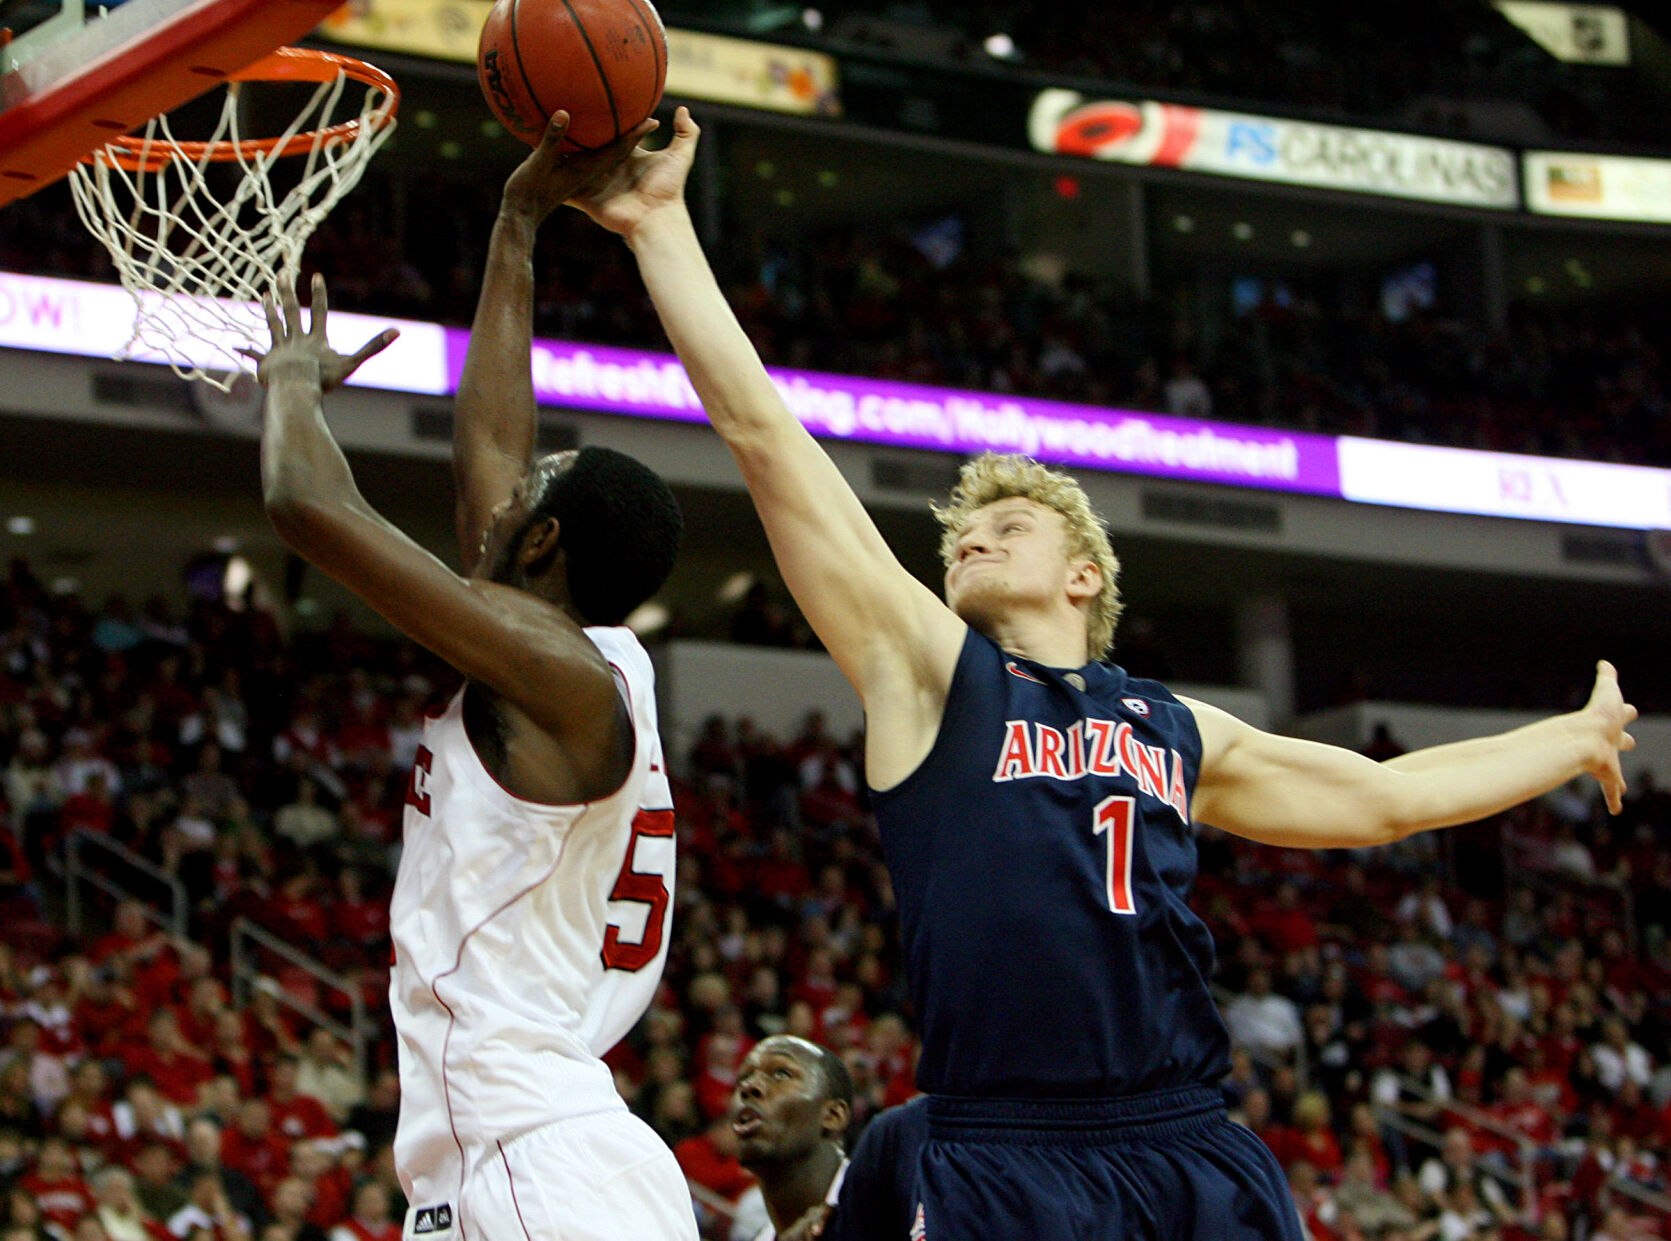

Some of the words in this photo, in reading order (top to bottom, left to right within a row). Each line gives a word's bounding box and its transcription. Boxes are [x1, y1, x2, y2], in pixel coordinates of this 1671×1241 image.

[992, 717, 1189, 826] ARIZONA
[600, 806, 675, 972] 5
[1093, 795, 1136, 915] 1
